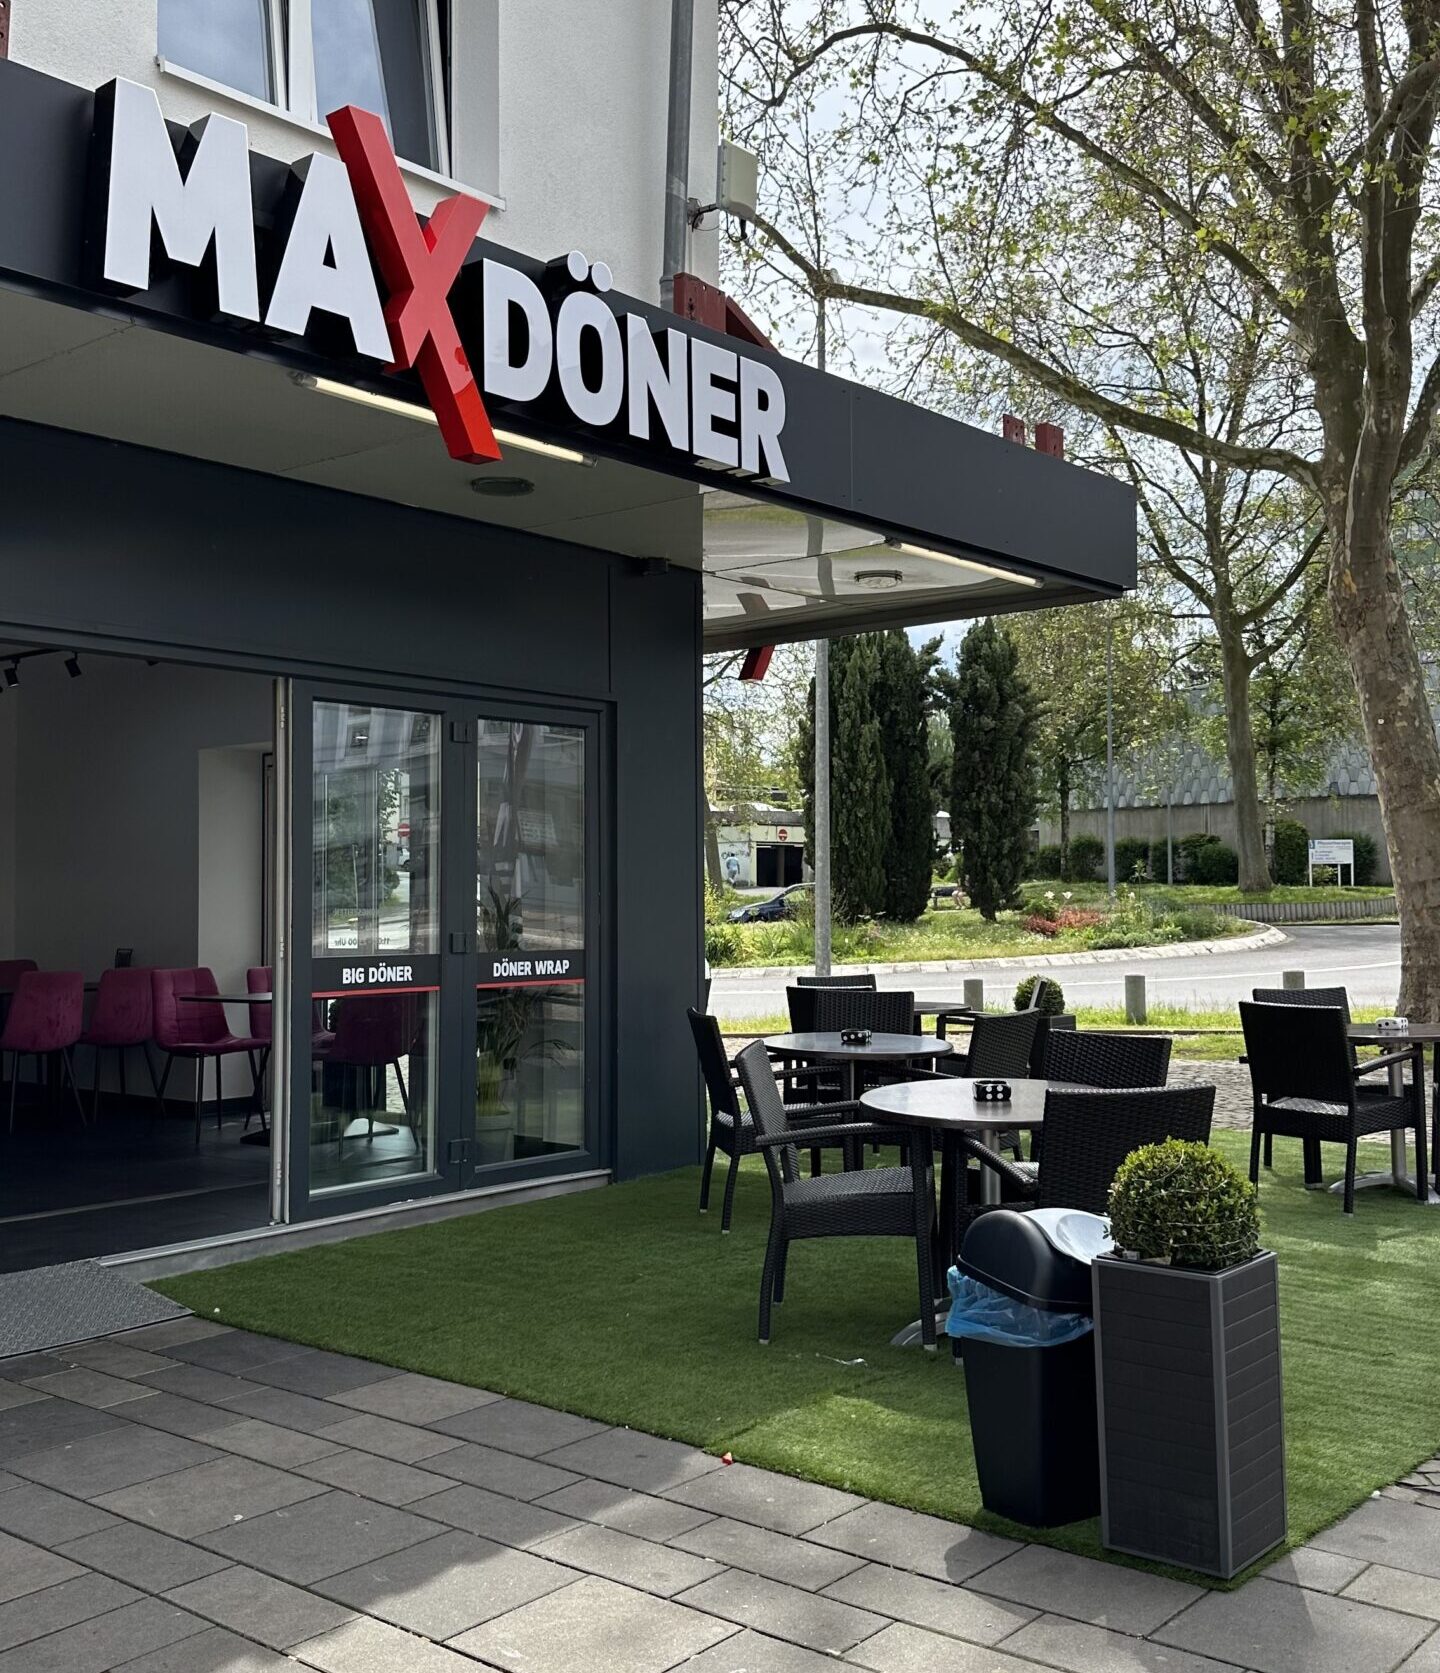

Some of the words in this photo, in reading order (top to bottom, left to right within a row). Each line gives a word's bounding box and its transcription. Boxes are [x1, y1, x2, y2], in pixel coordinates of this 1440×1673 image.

[103, 77, 502, 464] MAX
[483, 249, 791, 483] DÖNER
[342, 967, 365, 984] BIG
[368, 962, 413, 983] DÖNER
[493, 957, 532, 977] DÖNER
[535, 959, 570, 976] WRAP
